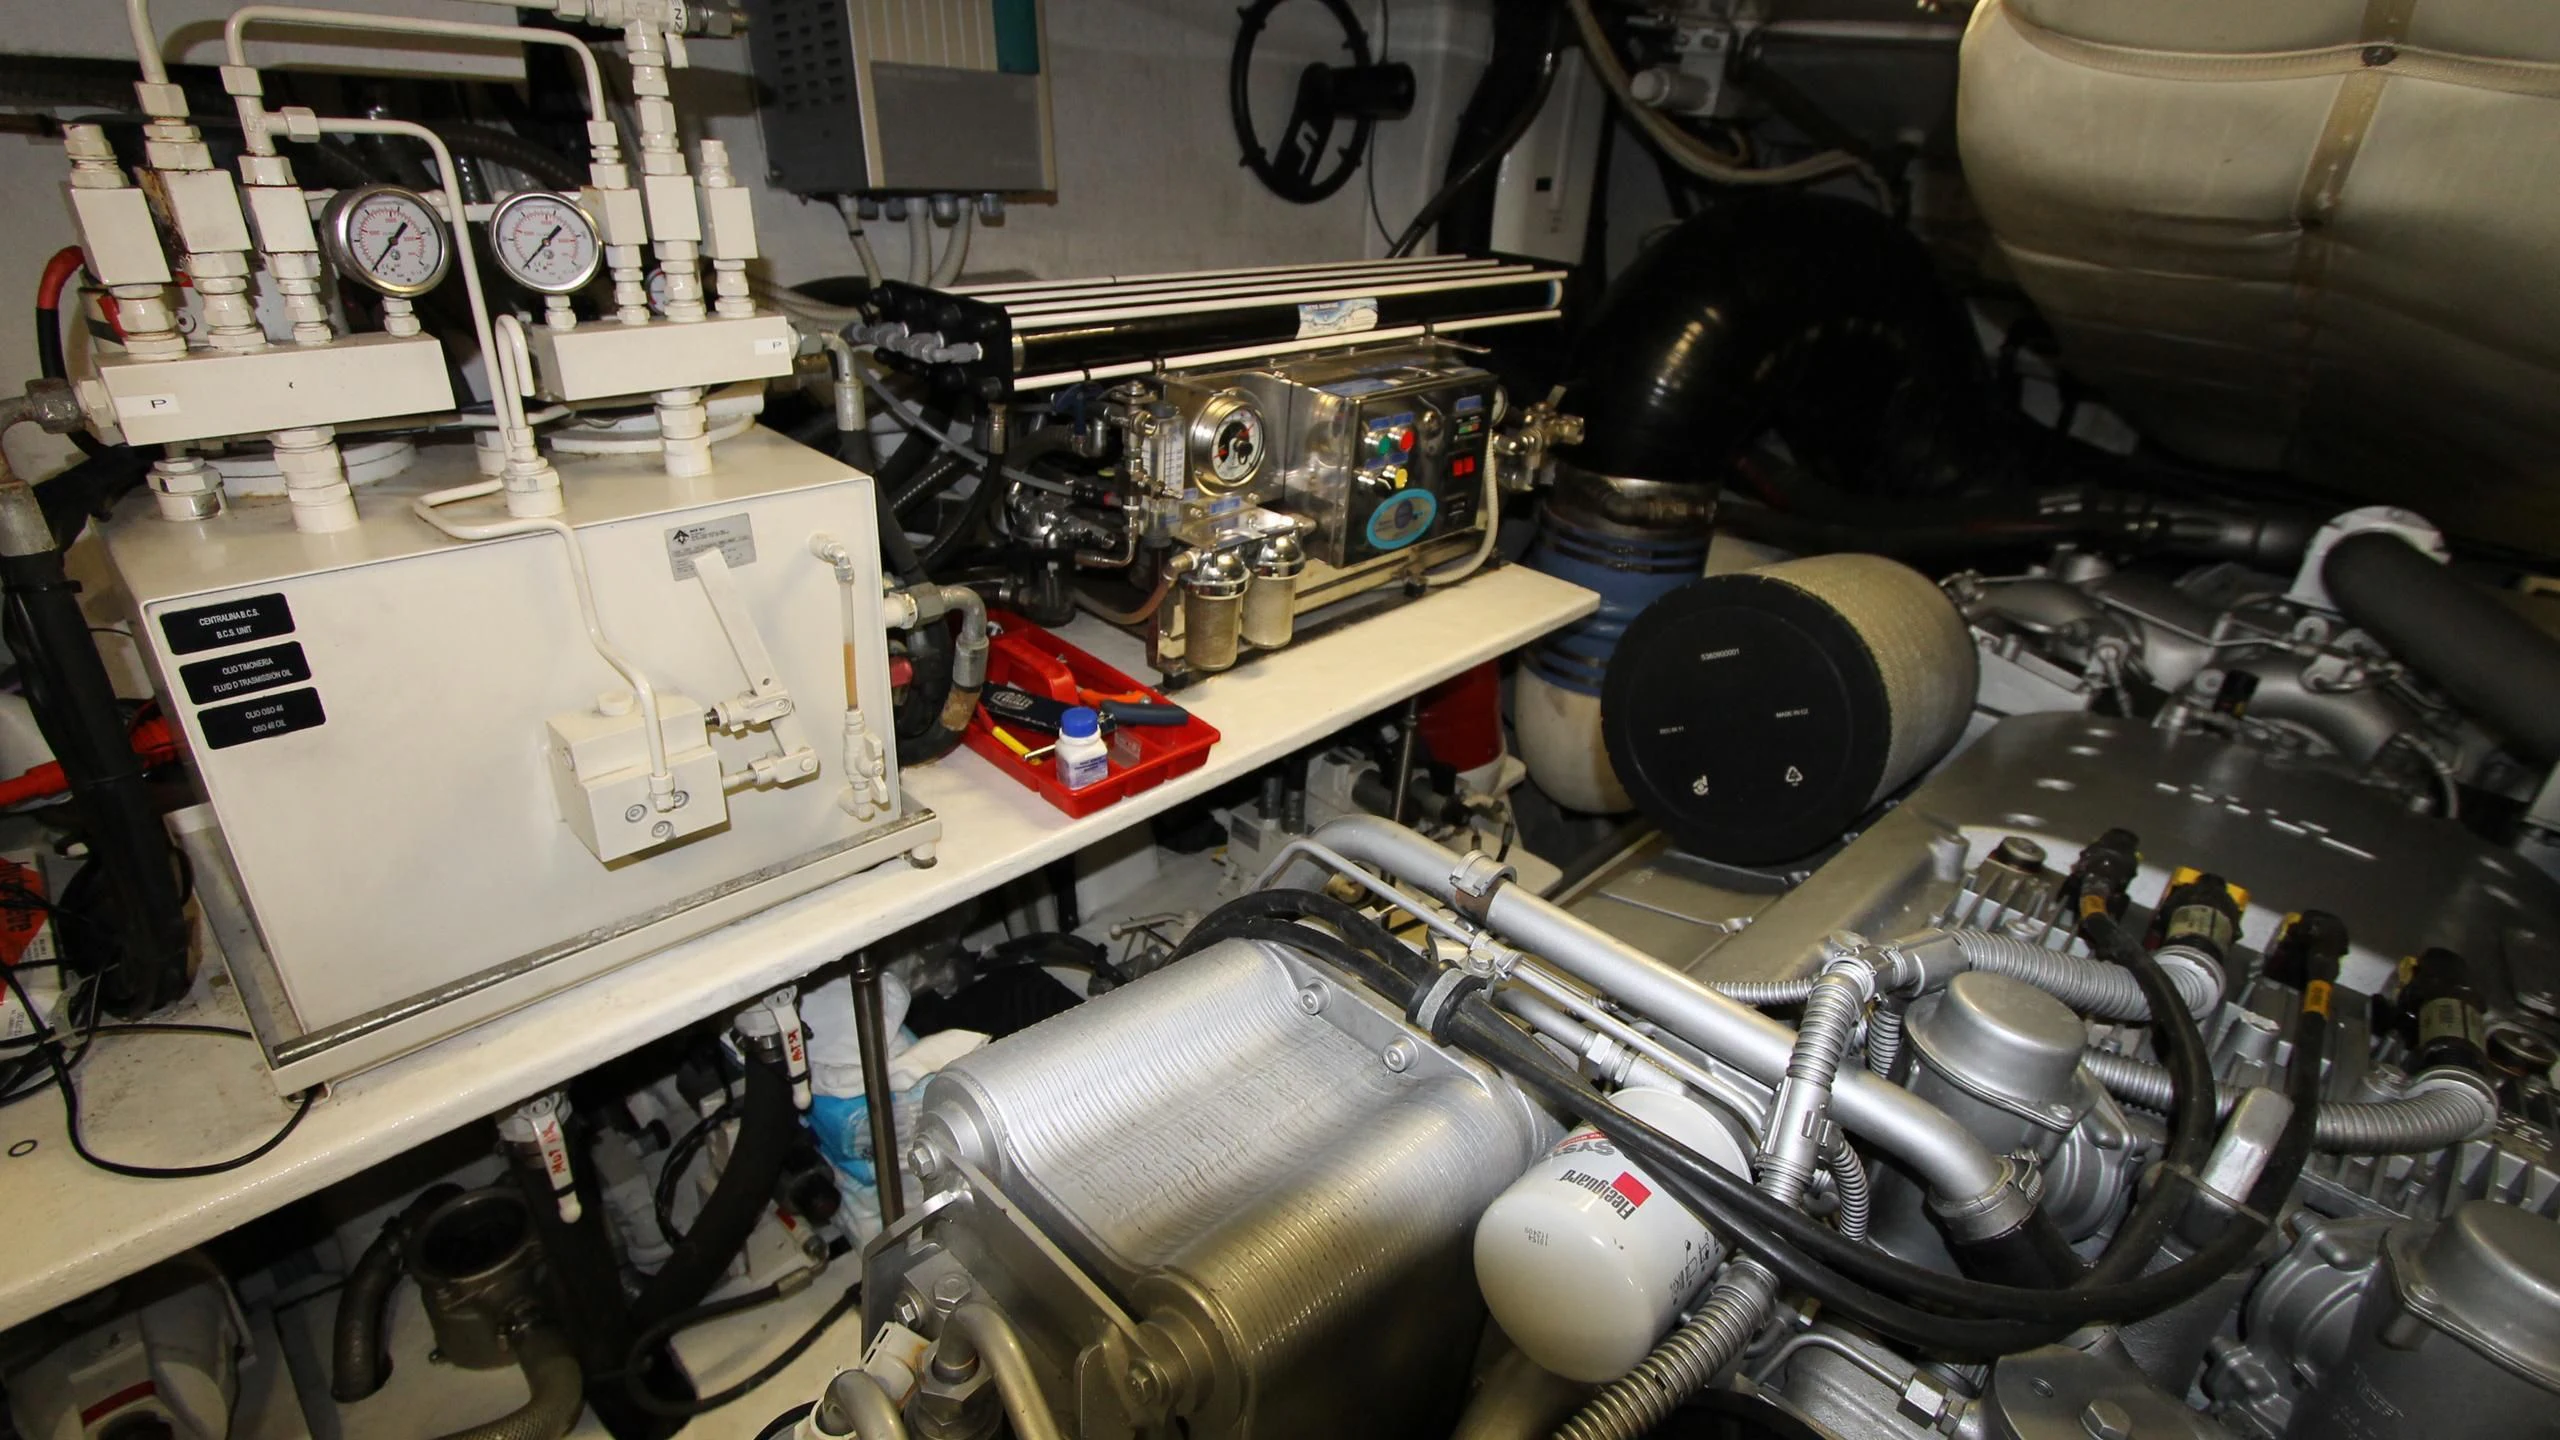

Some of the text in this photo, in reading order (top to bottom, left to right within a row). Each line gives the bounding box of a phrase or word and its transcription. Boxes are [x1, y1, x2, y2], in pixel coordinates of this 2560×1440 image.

[773, 341, 782, 349] P
[151, 399, 167, 408] P
[199, 609, 260, 626] CENTRALINA B.C.S.
[216, 625, 252, 639] B.C.S. UNIT
[222, 658, 274, 675] OLIO TIMONERIA
[212, 683, 233, 693] FLUID
[233, 681, 239, 689] D
[281, 669, 293, 678] OIL
[245, 710, 261, 719] OLIO
[275, 719, 287, 728] OIL
[1557, 1168, 1636, 1220] Fleetguard
